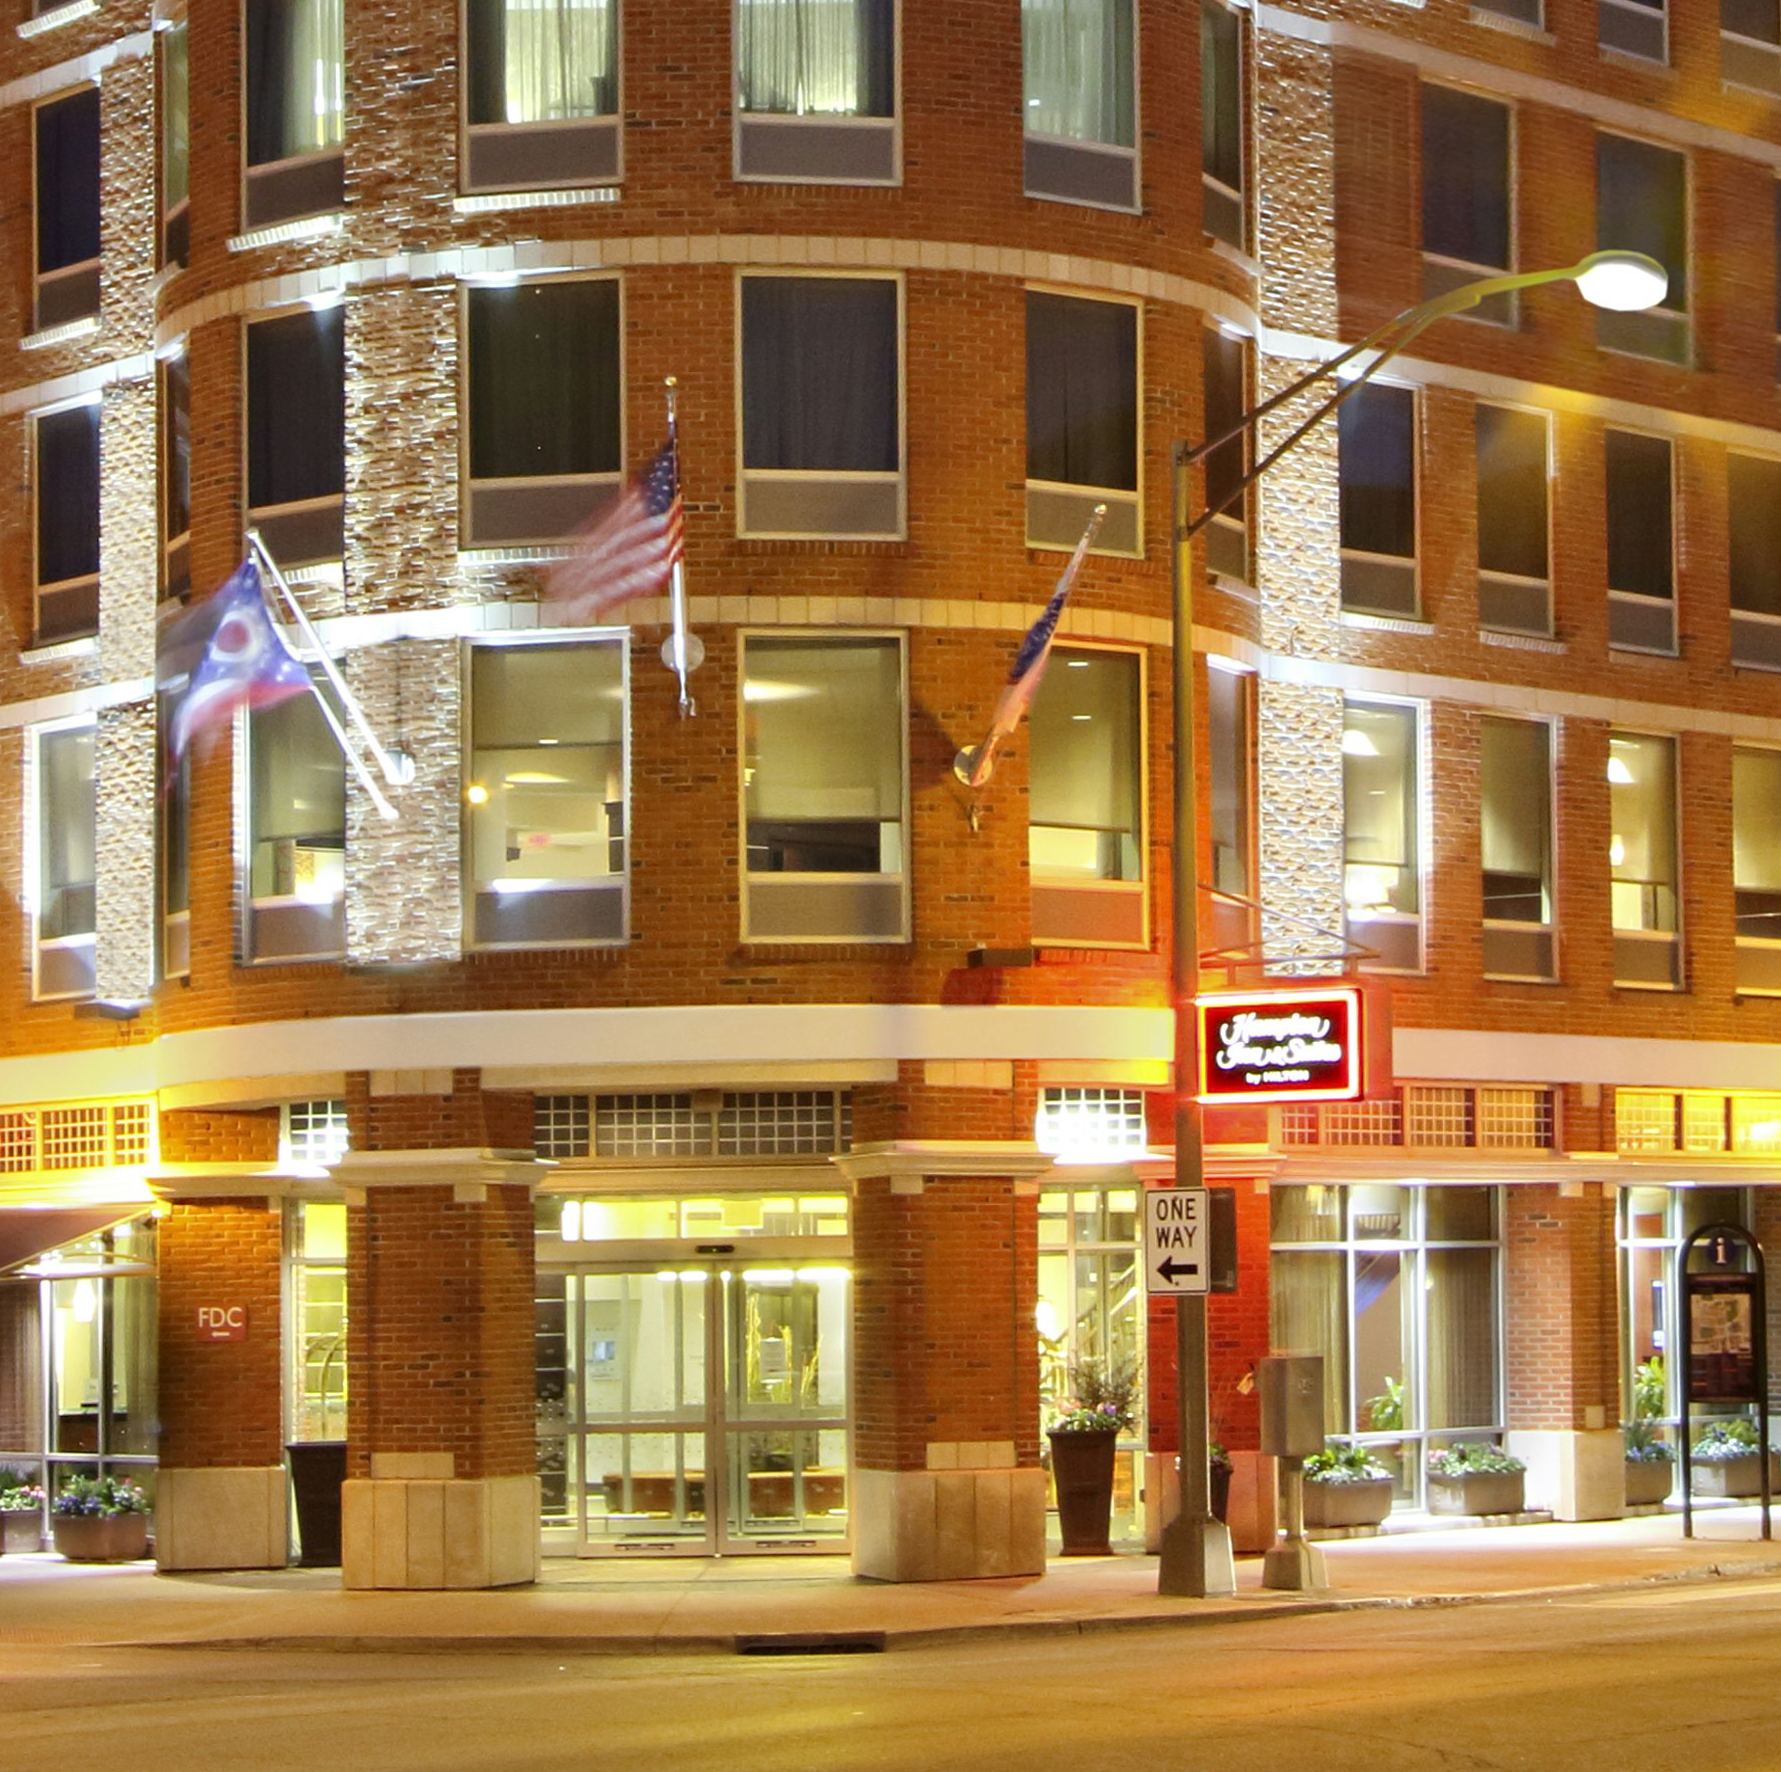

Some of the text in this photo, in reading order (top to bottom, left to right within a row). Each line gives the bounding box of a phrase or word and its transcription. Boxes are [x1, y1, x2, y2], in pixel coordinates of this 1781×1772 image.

[1220, 1012, 1330, 1045] Hampton
[1216, 1041, 1268, 1069] Inn
[1246, 1070, 1310, 1085] by HILTON
[1156, 1198, 1196, 1220] ONE
[1156, 1226, 1197, 1248] WAY
[199, 1307, 242, 1328] FDC
